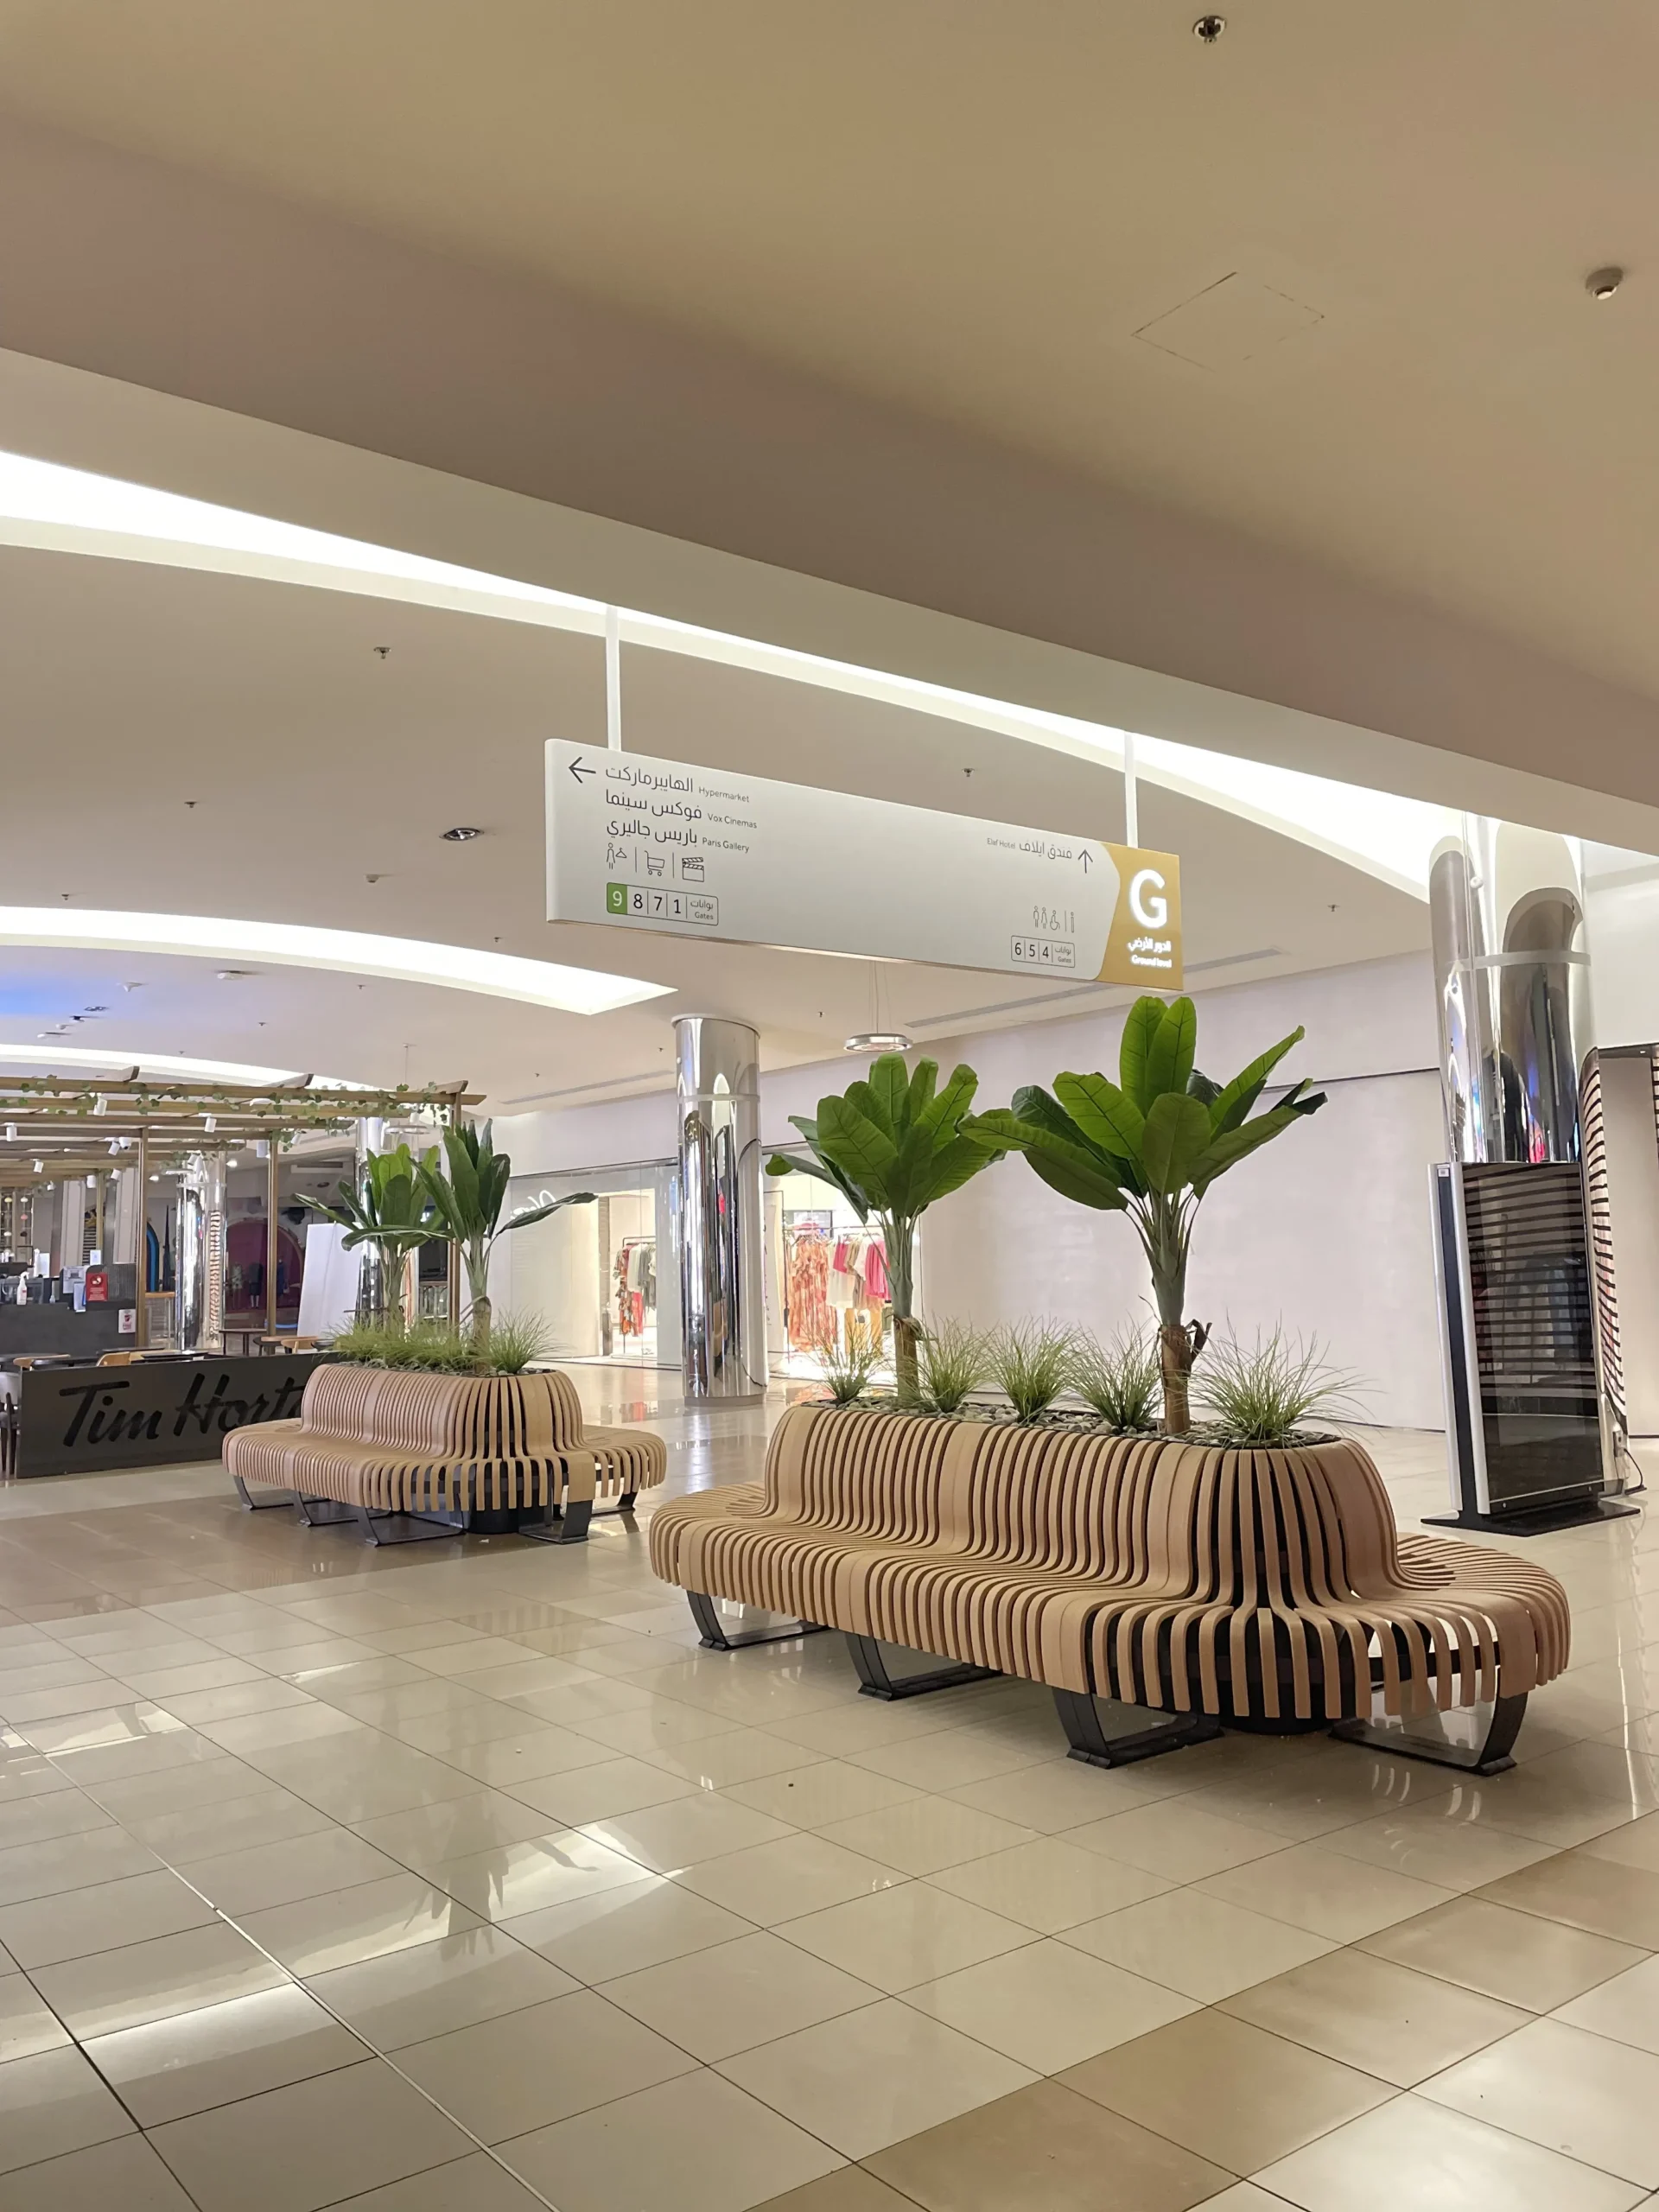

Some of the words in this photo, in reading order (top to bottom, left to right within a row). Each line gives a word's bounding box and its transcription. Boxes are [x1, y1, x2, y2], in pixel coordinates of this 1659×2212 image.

[606, 766, 693, 792] الهايبرماركت
[606, 789, 647, 811] سينما
[698, 786, 750, 803] Hypermarket
[652, 802, 702, 822] فوكس
[708, 812, 723, 823] Vox
[724, 816, 758, 829] Cinemas
[607, 819, 651, 839] جاليري
[655, 828, 697, 848] باريس
[702, 836, 721, 848] Paris
[722, 840, 750, 854] Gallery
[999, 840, 1016, 849] Hotel
[1047, 843, 1071, 860] فندق
[612, 891, 622, 906] 9
[633, 893, 643, 909] 8
[653, 896, 663, 912] 7
[673, 899, 682, 914] 1
[1129, 869, 1167, 929] G
[695, 912, 714, 920] Gates
[1014, 942, 1022, 956] 6
[1028, 944, 1036, 957] 5
[1042, 945, 1050, 958] 4
[1131, 954, 1157, 967] Ground
[59, 1381, 162, 1447] Tim
